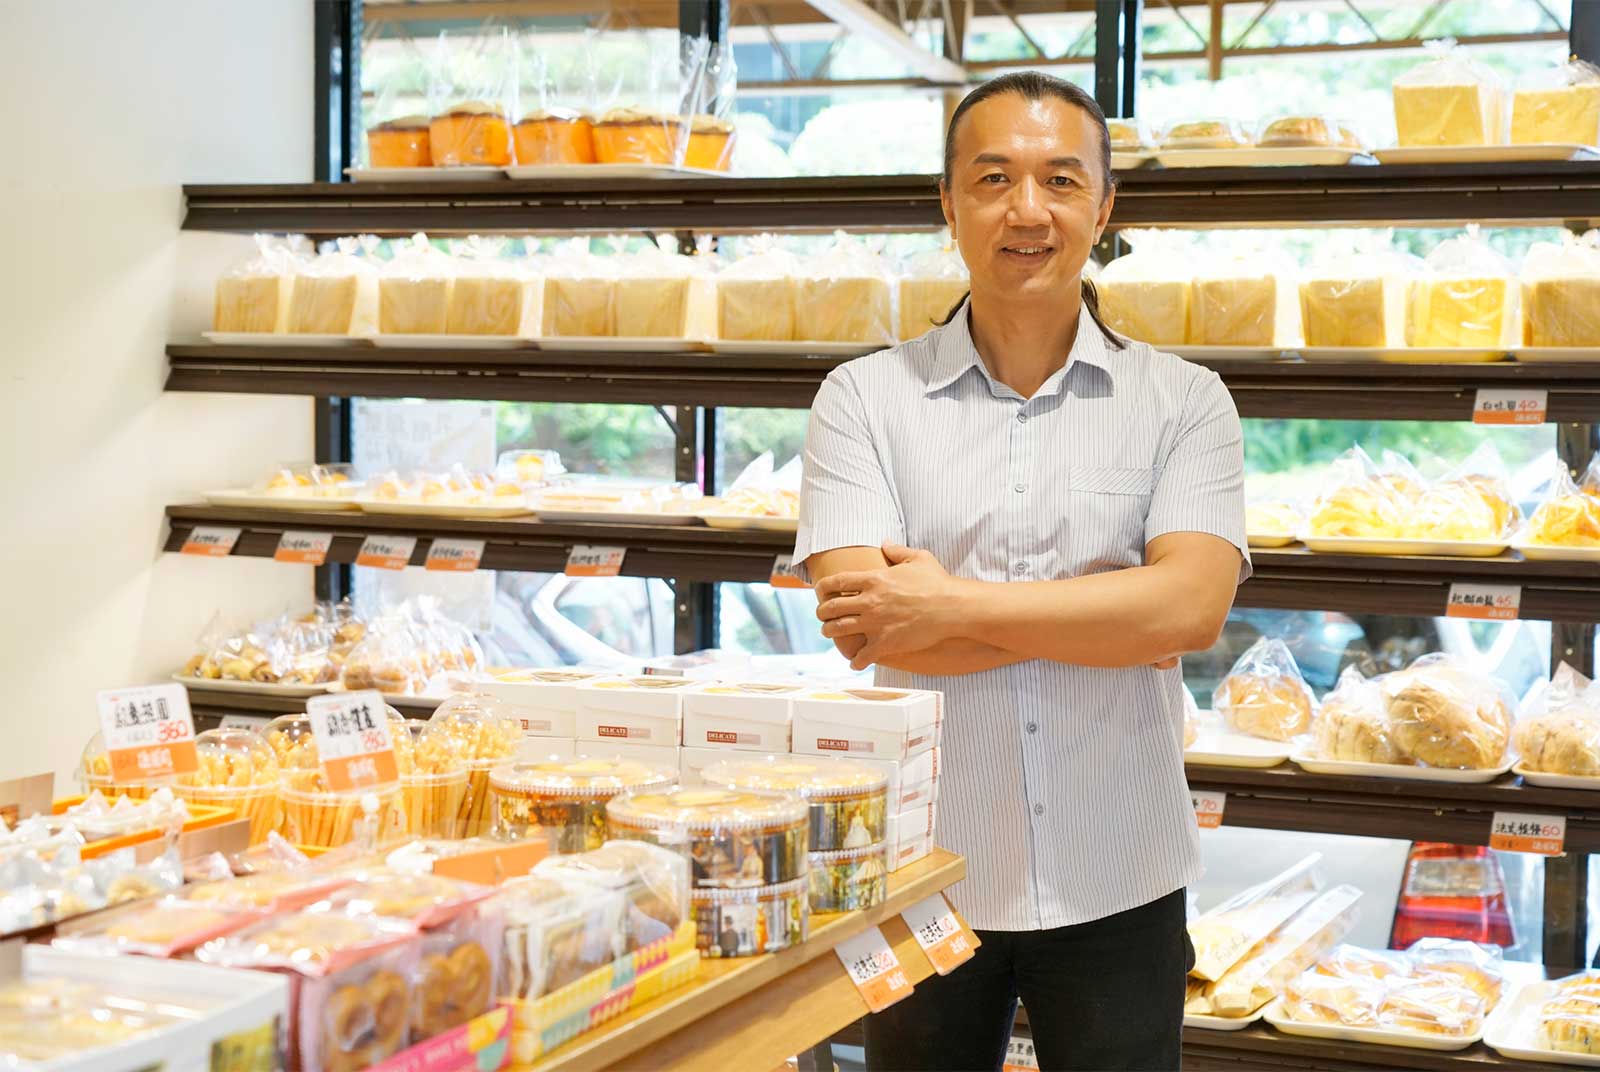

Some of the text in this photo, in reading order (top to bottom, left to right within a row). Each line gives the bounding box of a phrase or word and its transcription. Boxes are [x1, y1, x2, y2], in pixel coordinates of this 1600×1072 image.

[1520, 400, 1538, 412] 40
[158, 719, 188, 743] 360
[599, 726, 626, 735] DELICATE
[708, 732, 736, 741] DELICATE
[818, 740, 847, 749] DELICATE
[1542, 825, 1560, 836] 60
